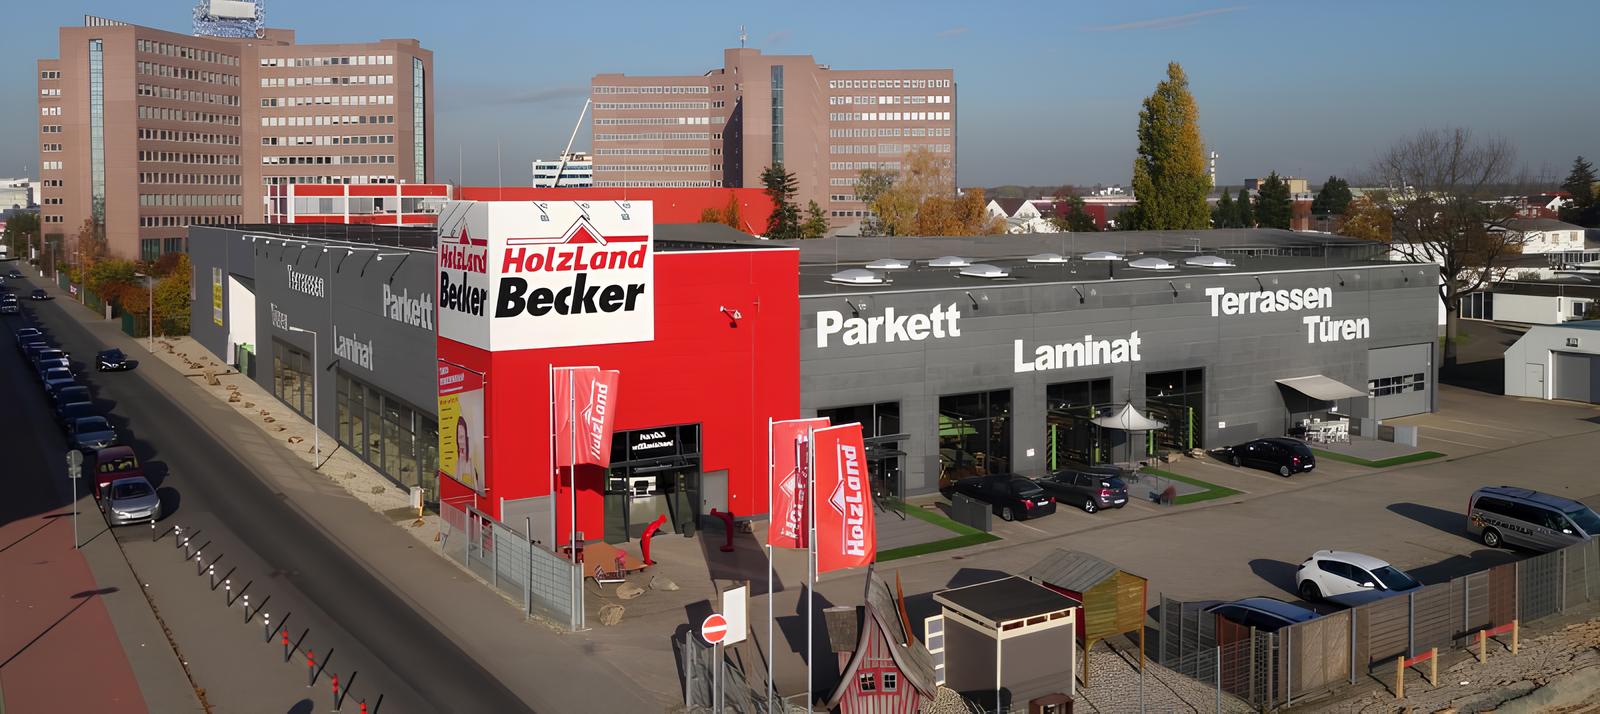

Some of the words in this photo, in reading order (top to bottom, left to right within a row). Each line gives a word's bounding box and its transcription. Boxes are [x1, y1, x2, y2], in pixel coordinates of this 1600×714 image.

[441, 244, 487, 274] HolzLand
[502, 245, 647, 273] HolzLand
[382, 283, 433, 331] Parkett
[439, 271, 488, 316] Becker
[494, 272, 645, 318] Becker
[1206, 285, 1333, 318] Terrassen
[817, 301, 961, 348] Parkett
[1303, 315, 1370, 344] Türen
[1014, 329, 1141, 373] Laminat
[841, 444, 865, 556] HolzLand
